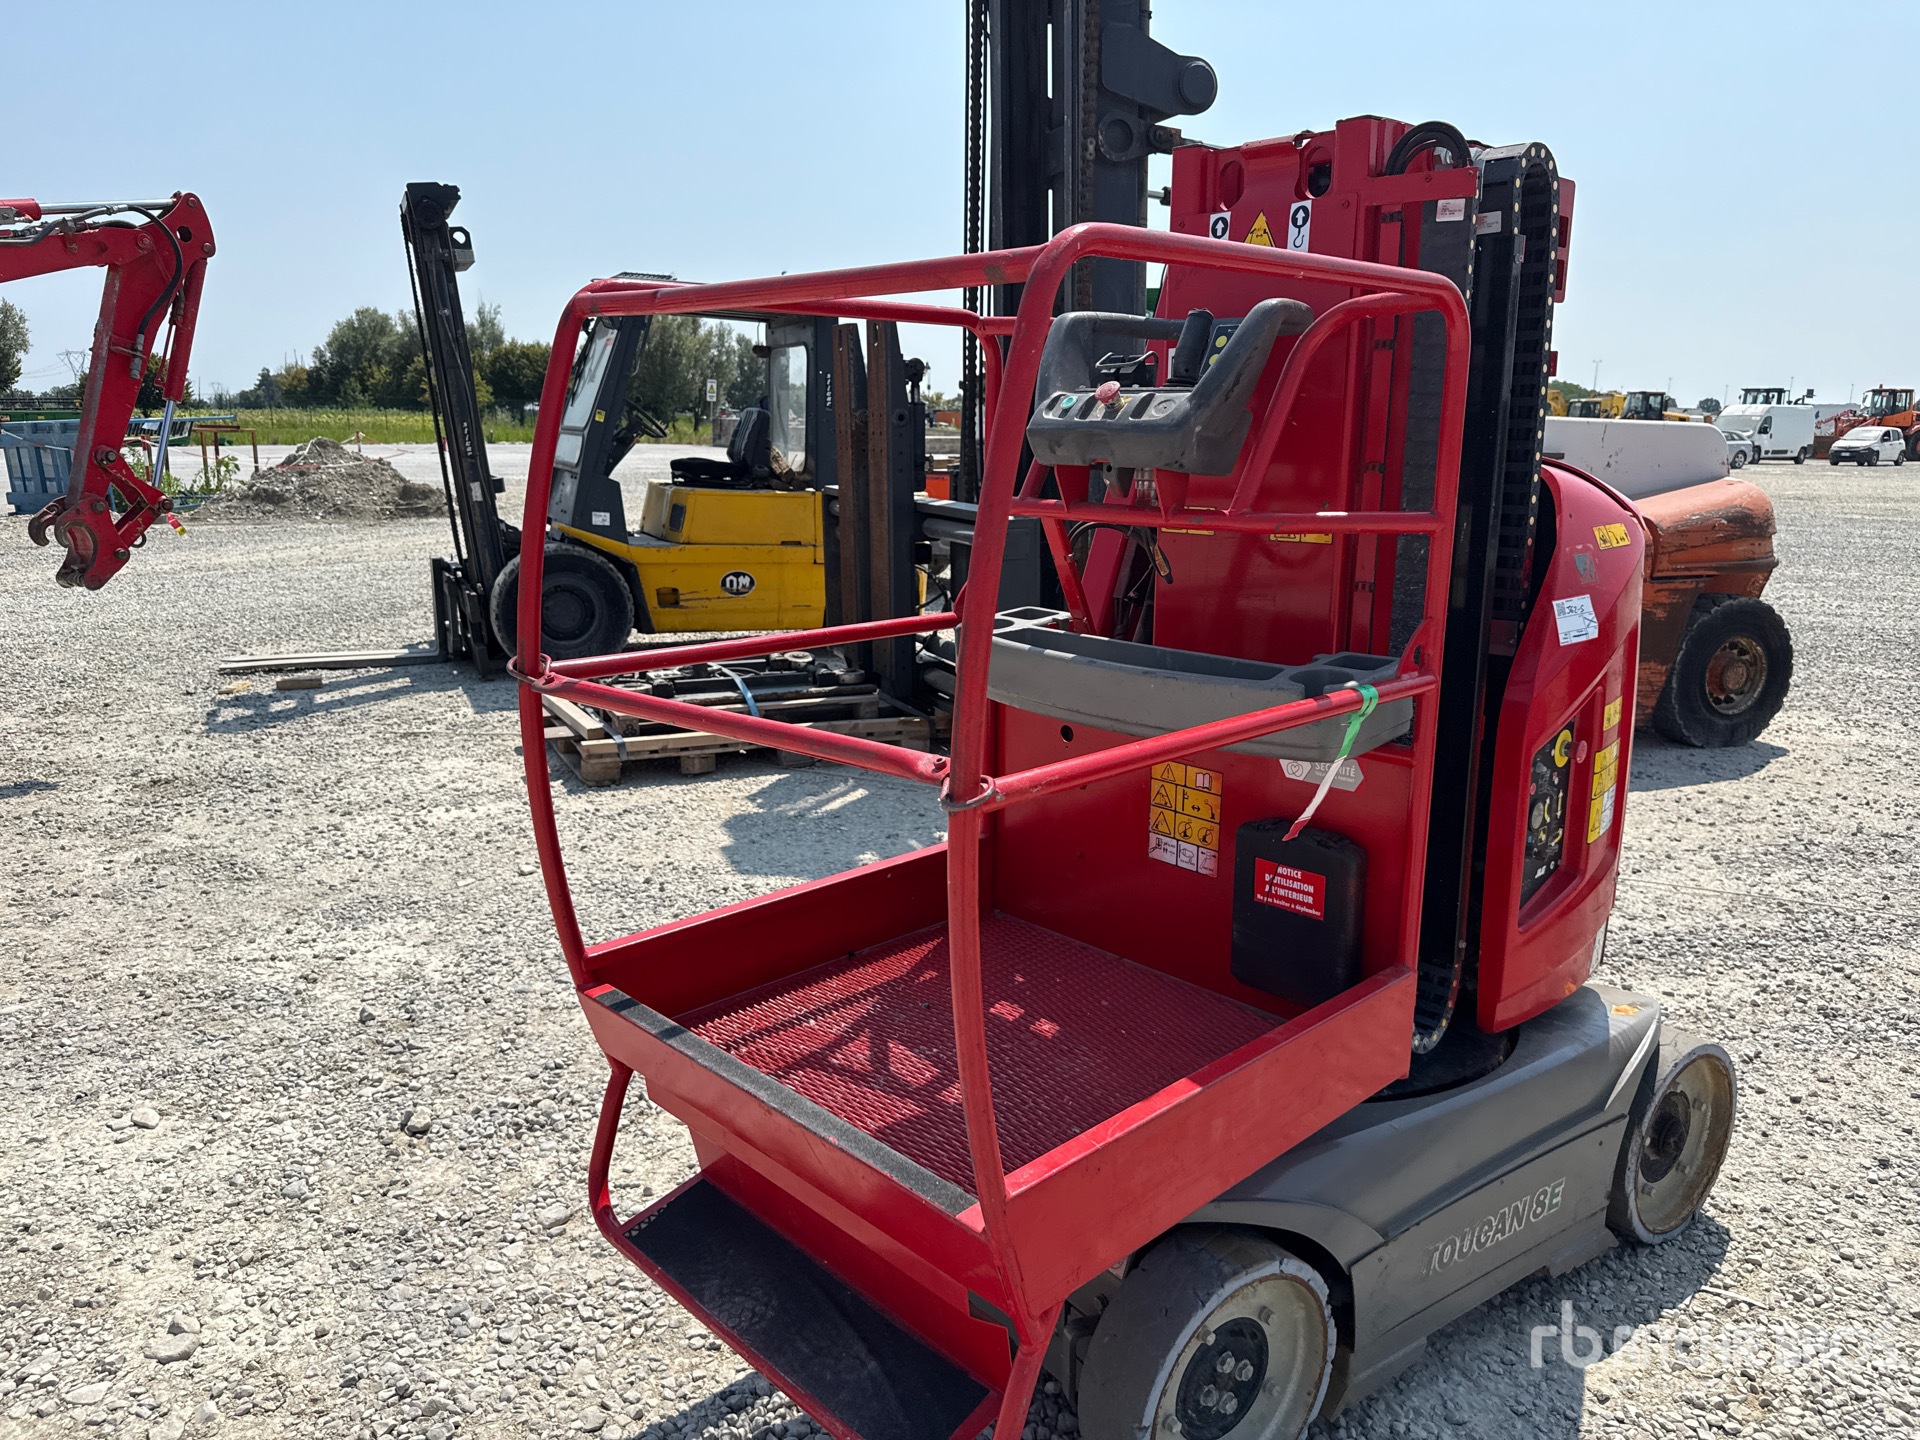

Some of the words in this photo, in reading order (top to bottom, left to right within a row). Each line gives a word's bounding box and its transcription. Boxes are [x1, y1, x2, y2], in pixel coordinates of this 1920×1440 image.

[1277, 866, 1302, 879] NOTICE
[1271, 885, 1314, 904] L'INTERIEUR
[1421, 1195, 1531, 1277] TOUCAN
[1530, 1177, 1566, 1222] 8E
